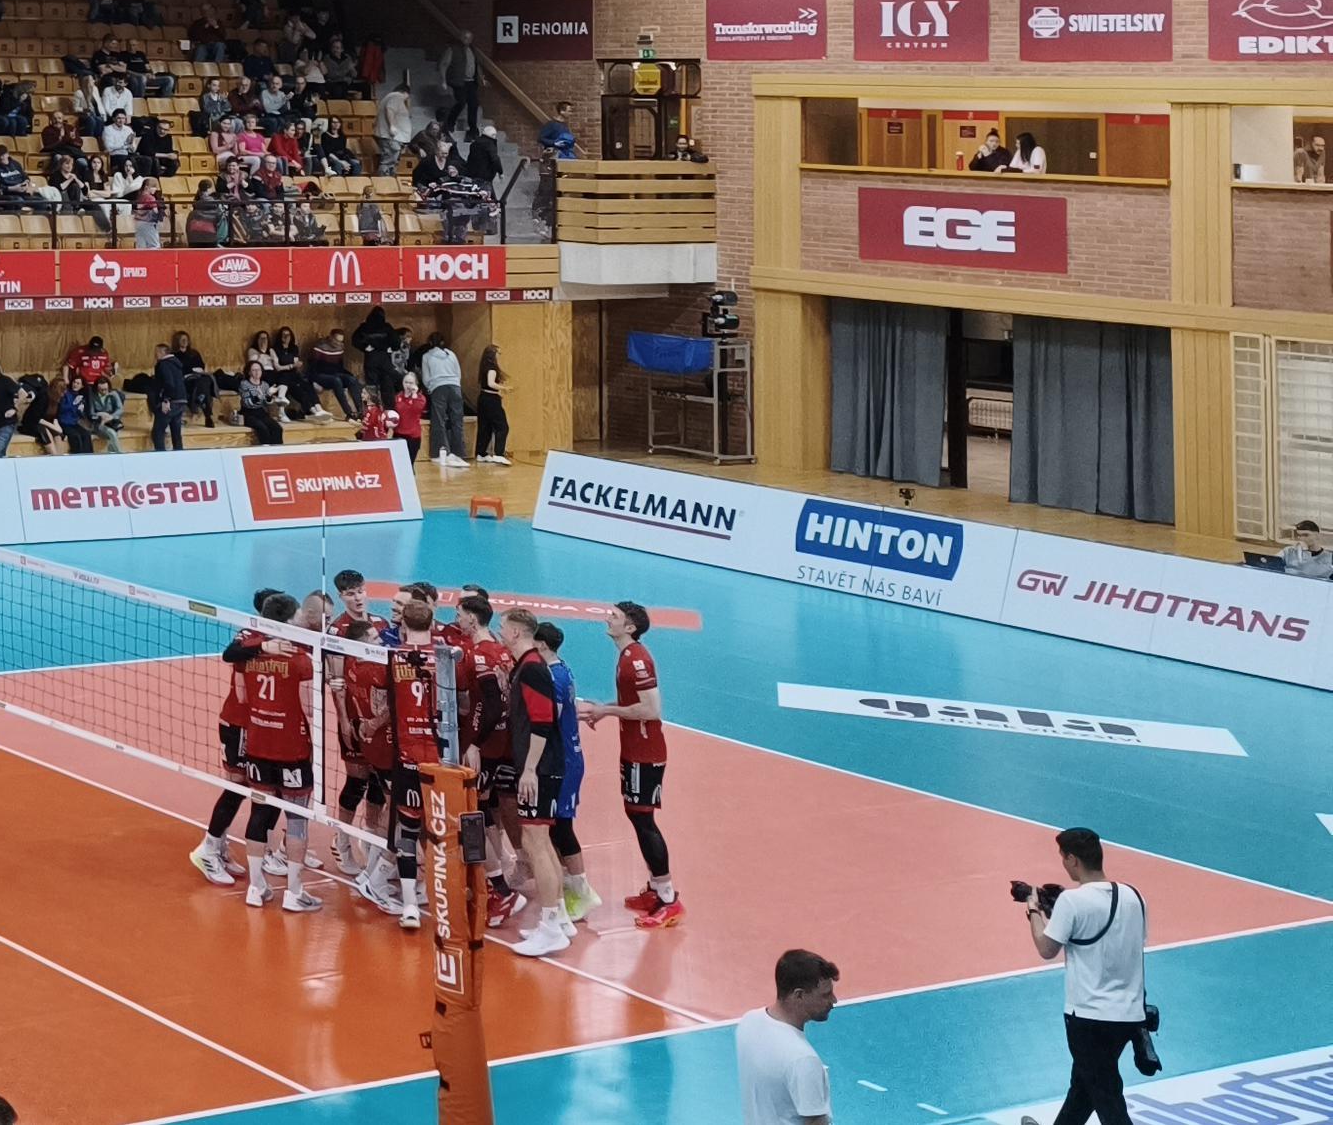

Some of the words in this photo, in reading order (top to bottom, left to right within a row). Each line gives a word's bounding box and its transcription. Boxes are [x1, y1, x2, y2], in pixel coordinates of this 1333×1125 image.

[880, 1, 961, 37] IGY
[1069, 14, 1165, 32] SWIETELSKY
[522, 22, 588, 35] RENOMIA
[903, 205, 1016, 253] EGE
[218, 259, 251, 271] JAWA
[418, 253, 488, 281] HOCH
[49, 298, 70, 308] HOCH
[126, 297, 147, 306] HOCH
[199, 296, 226, 306] HOCH
[276, 294, 296, 303] HOCH
[385, 292, 403, 301] HOCH
[455, 291, 473, 300] HOCH
[524, 290, 550, 299] HOCH
[296, 473, 353, 494] SKUPINA
[356, 470, 381, 489] ČEZ
[549, 476, 736, 531] FACKELMANN
[805, 512, 953, 566] HINTON
[797, 564, 857, 592] STAVĚT
[862, 576, 896, 598] NÁS
[901, 584, 942, 607] BAVÍ
[487, 598, 578, 612] KUPINA
[1016, 569, 1067, 598] GW
[1073, 580, 1309, 642] JIHOTRANS
[257, 674, 275, 701] 21
[434, 842, 451, 940] SKUPINA
